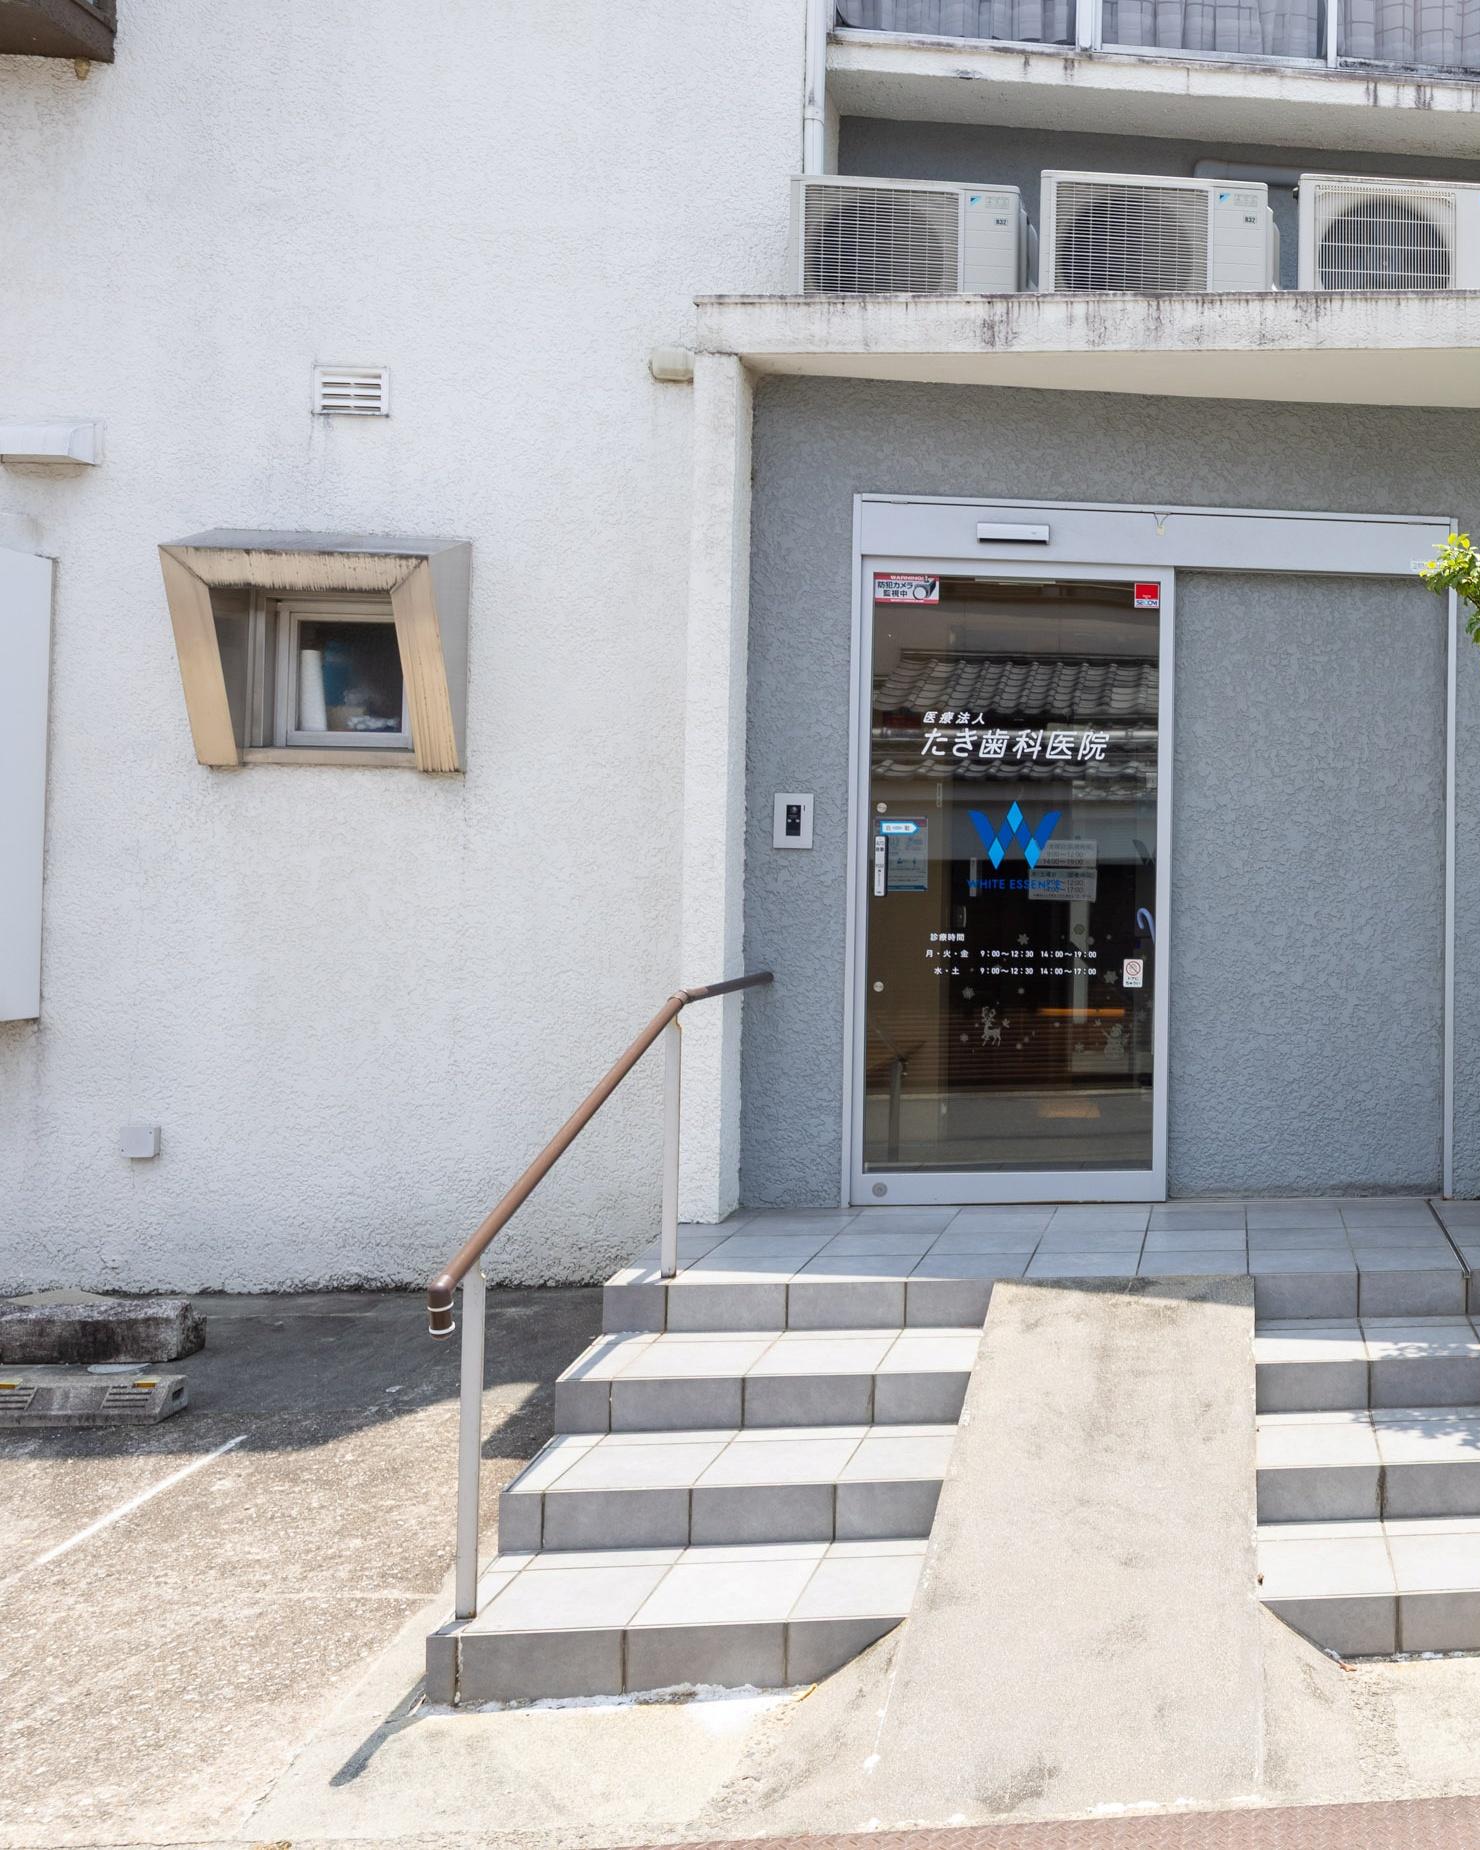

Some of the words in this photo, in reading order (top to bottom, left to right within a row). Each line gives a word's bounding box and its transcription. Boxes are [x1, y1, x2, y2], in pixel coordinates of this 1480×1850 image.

[877, 581, 913, 590] 防犯カメラ
[883, 589, 908, 598] 監視中
[923, 710, 986, 725] 医療法人
[920, 727, 1110, 761] たき歯科医院
[966, 878, 1006, 890] WHITE
[1009, 879, 1064, 891] ESSENCE
[929, 932, 965, 942] 診療時間
